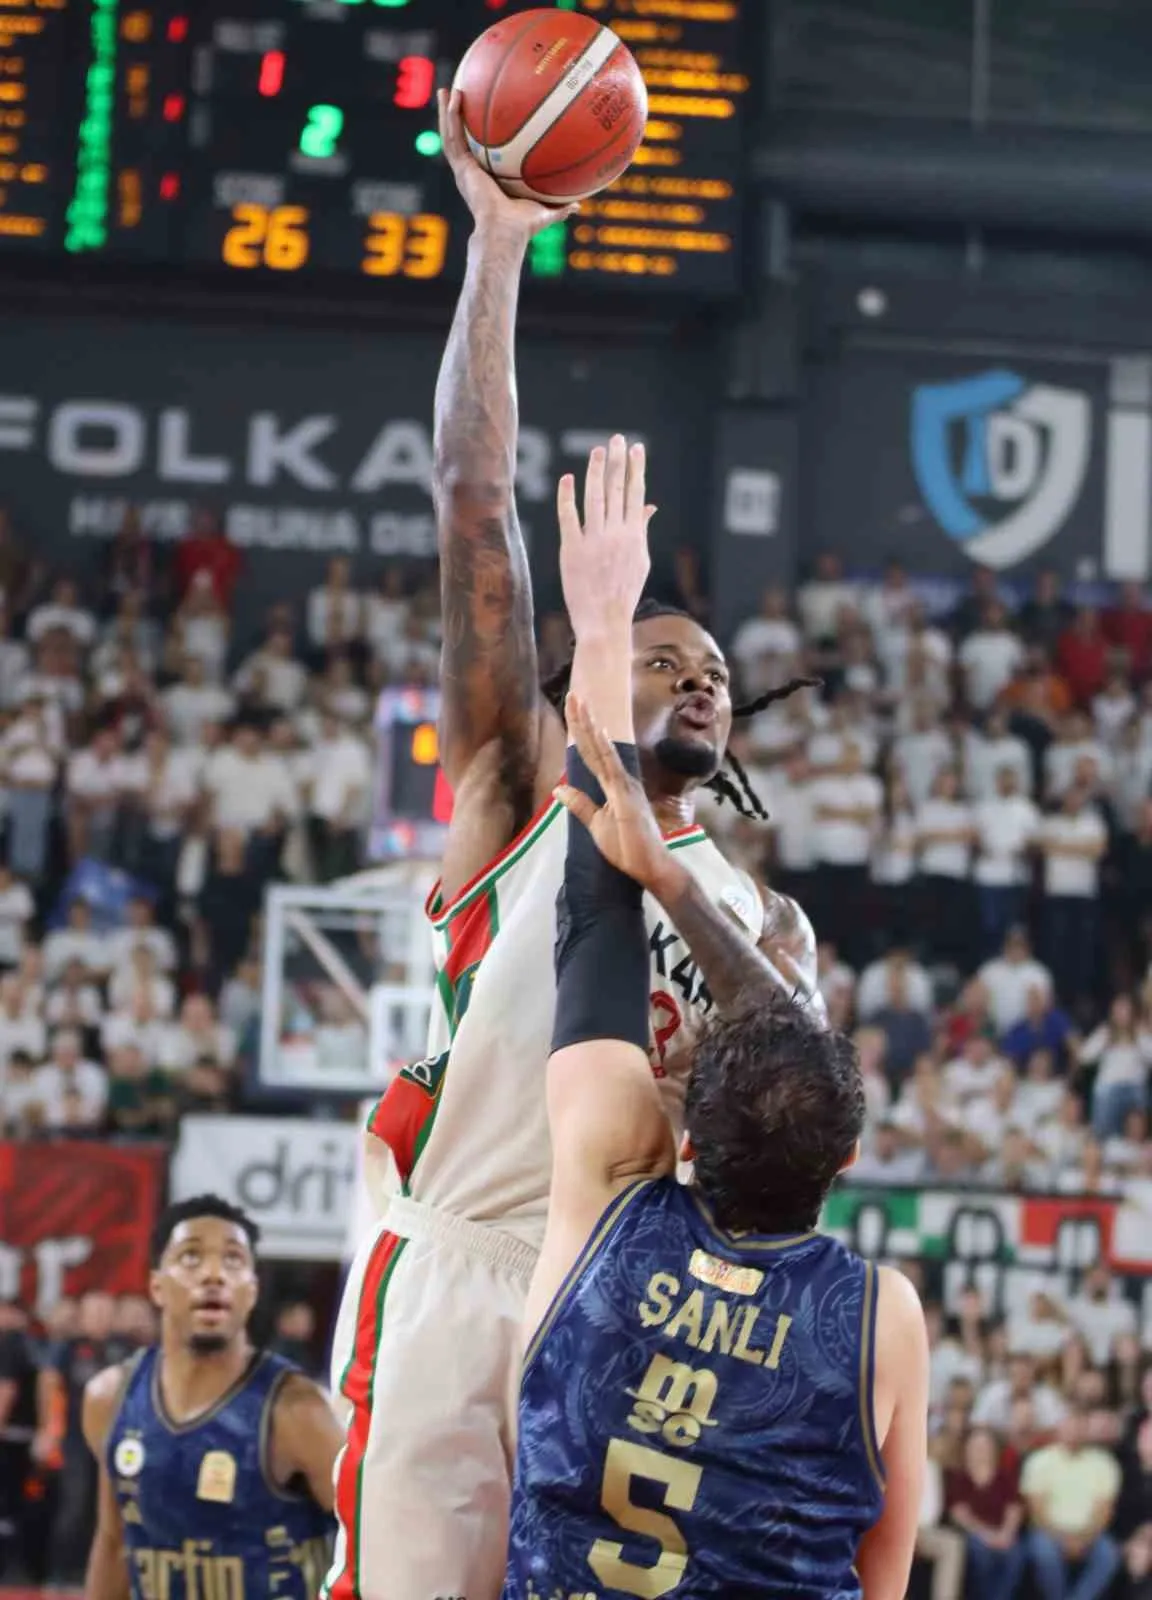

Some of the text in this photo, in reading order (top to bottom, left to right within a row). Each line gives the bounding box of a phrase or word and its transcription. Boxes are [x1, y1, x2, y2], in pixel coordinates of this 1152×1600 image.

[222, 201, 310, 271] 26
[360, 211, 448, 279] 33
[237, 1138, 355, 1213] dri
[587, 1437, 703, 1600] 5
